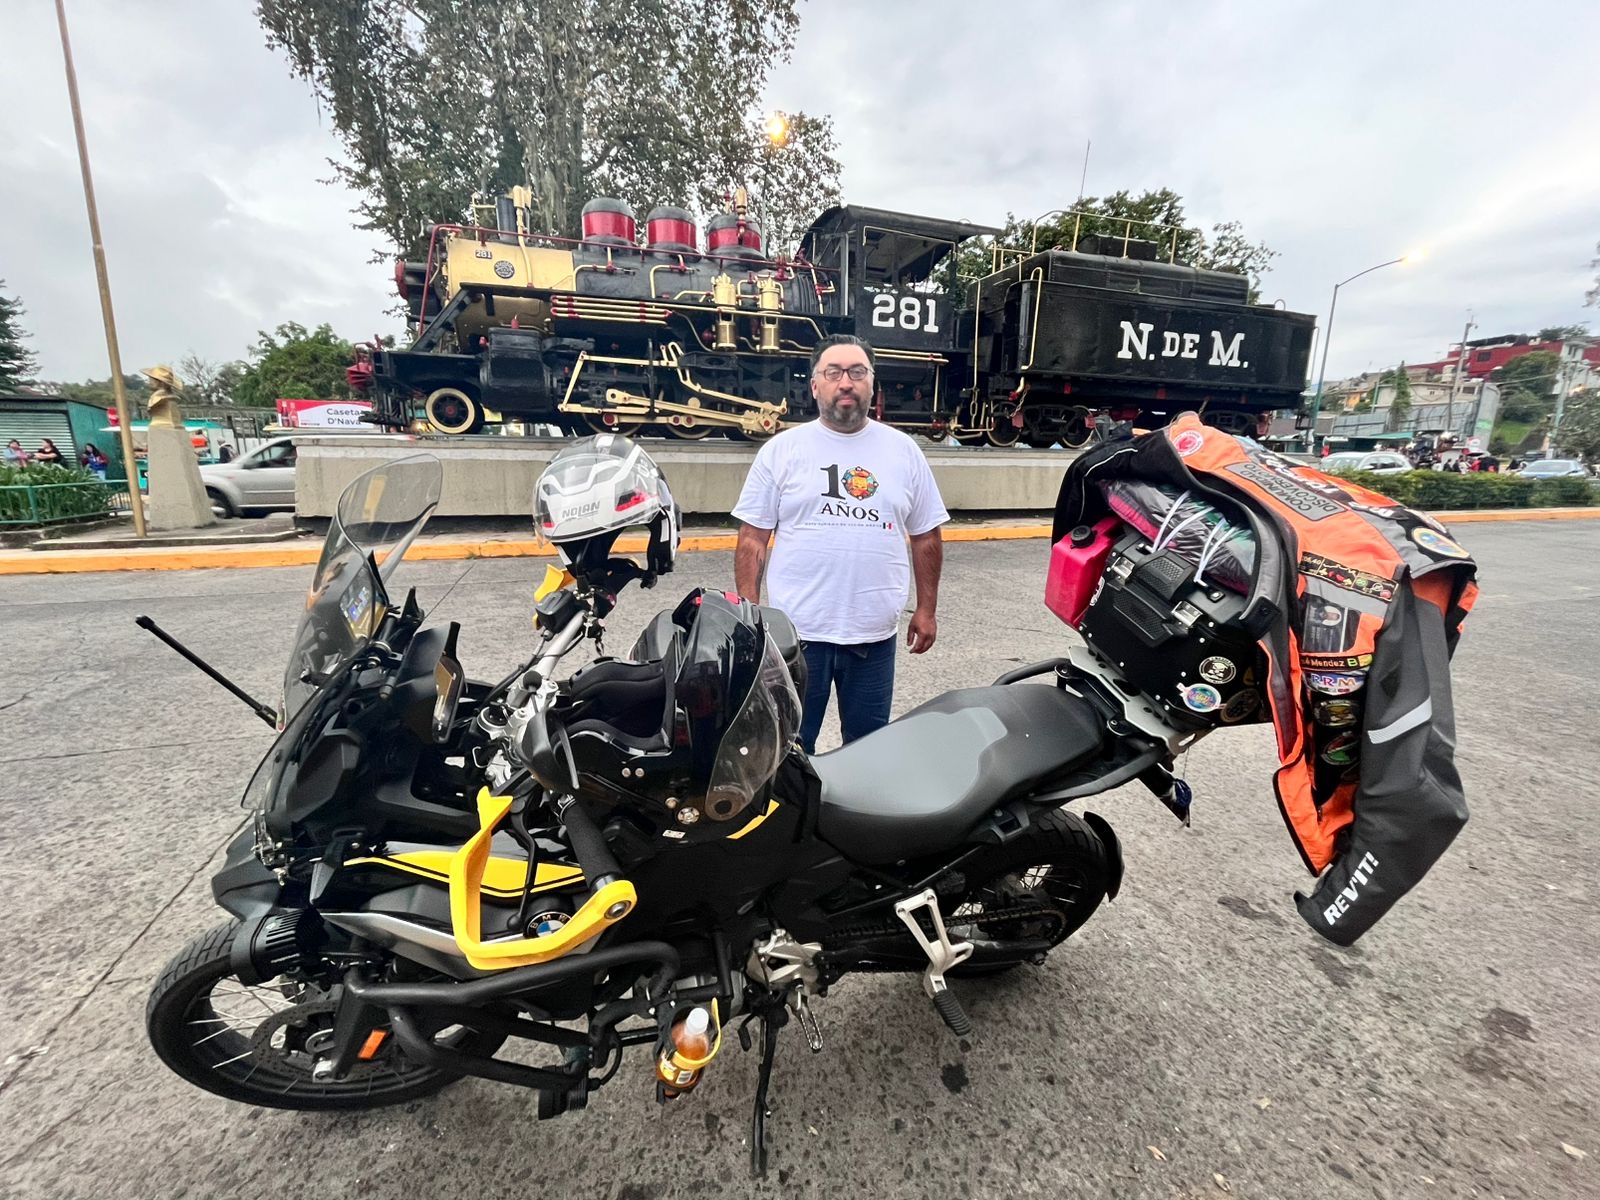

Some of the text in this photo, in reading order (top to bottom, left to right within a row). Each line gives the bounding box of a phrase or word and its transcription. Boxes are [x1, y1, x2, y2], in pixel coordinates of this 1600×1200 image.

[872, 294, 939, 333] 281
[1117, 320, 1249, 369] N. DE M.
[326, 408, 360, 416] Caseta
[1240, 470, 1313, 512] COMUNIDAD
[562, 501, 600, 519] NOLAN
[820, 501, 879, 522] AÑOS
[1323, 851, 1379, 926] REV'IT!
[530, 914, 568, 929] BMW
